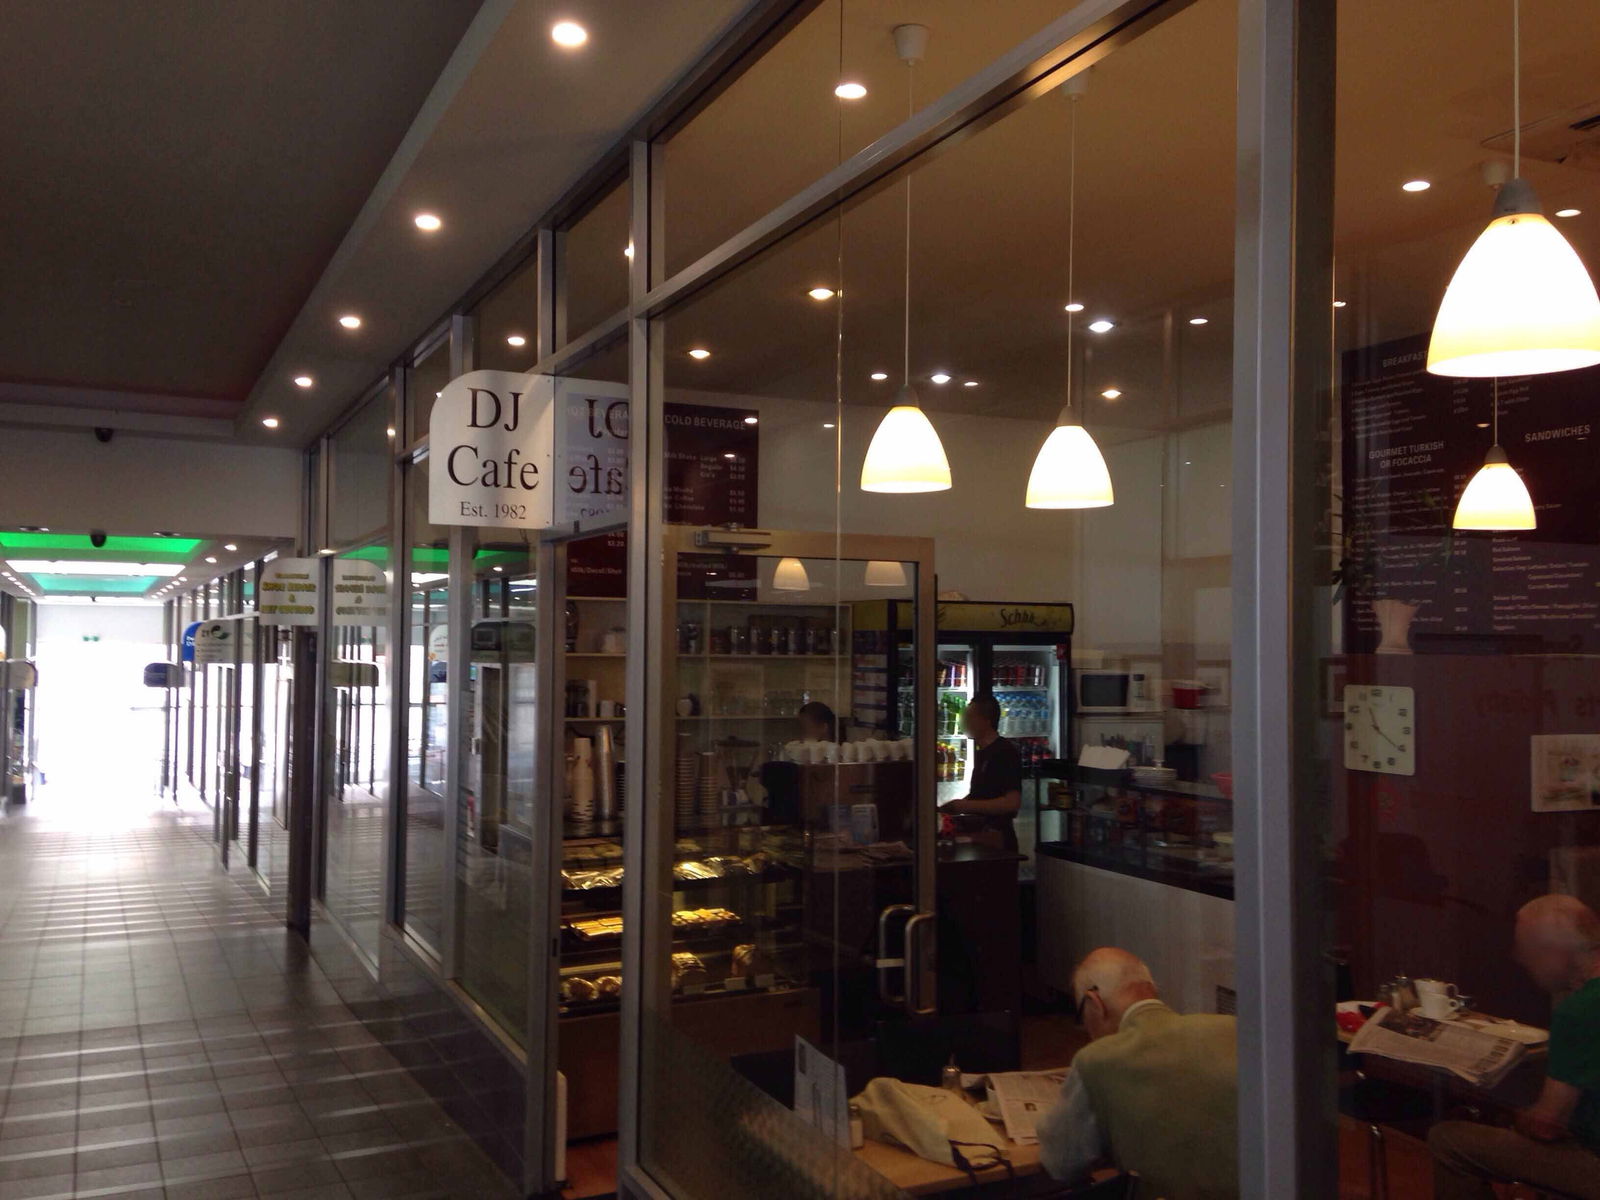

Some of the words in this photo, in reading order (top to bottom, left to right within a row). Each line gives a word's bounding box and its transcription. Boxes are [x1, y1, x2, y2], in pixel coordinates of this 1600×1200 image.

[466, 387, 523, 432] DJ
[664, 414, 692, 426] COLD
[1524, 423, 1591, 443] SANDWICHES
[1368, 446, 1408, 460] GOURMET
[1409, 440, 1445, 455] TURKISH
[1392, 453, 1432, 467] FOCACCIA
[447, 444, 540, 491] Cafe
[460, 501, 488, 518] Est.
[494, 504, 527, 520] 1982
